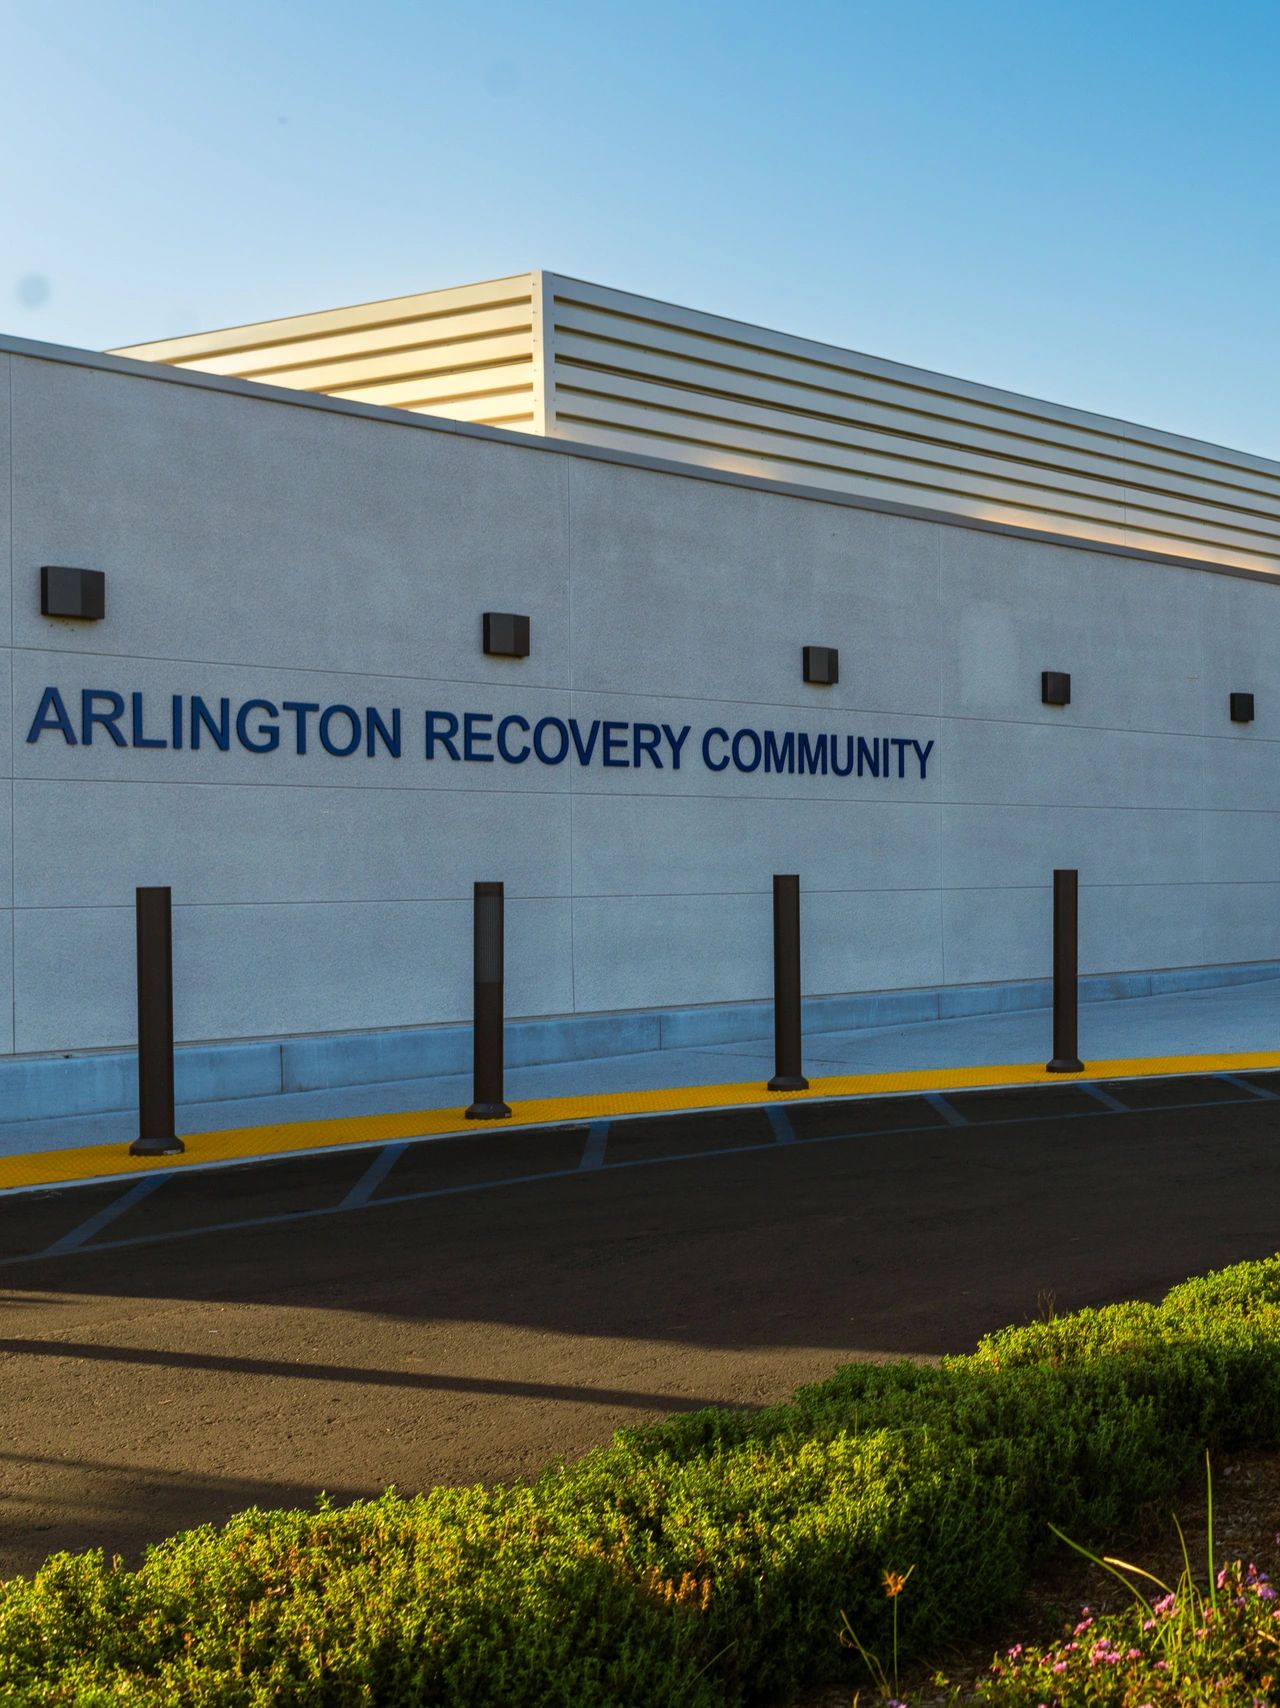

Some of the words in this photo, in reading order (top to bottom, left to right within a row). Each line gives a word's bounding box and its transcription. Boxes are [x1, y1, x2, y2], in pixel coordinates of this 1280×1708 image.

[26, 686, 402, 758] ARLINGTON
[424, 709, 692, 770] RECOVERY
[701, 726, 935, 779] COMMUNITY
